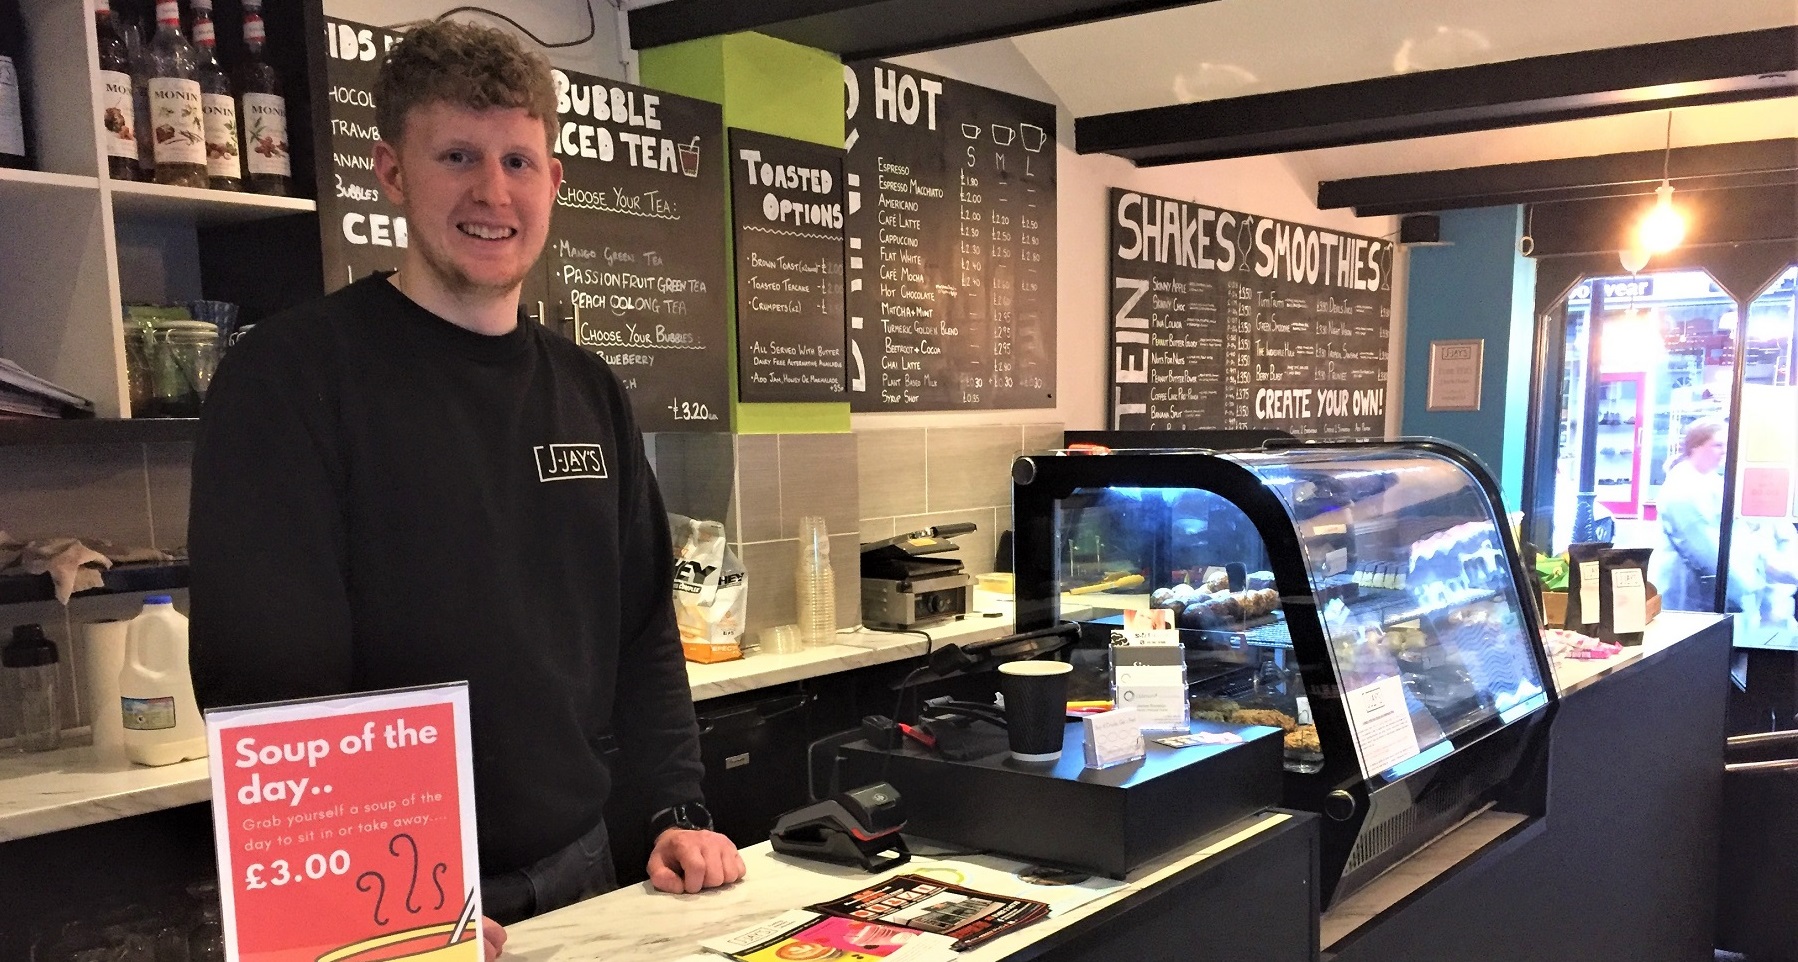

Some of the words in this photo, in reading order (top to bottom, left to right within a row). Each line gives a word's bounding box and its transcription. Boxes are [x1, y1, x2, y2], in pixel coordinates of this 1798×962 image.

[326, 23, 377, 62] IDS
[154, 89, 198, 102] MONIN
[551, 69, 661, 130] BUBBLE
[874, 66, 943, 131] HOT
[202, 106, 234, 116] ONIN
[619, 132, 678, 173] TEA
[967, 146, 976, 167] S
[996, 153, 1005, 170] M
[1026, 156, 1035, 177] L
[740, 149, 833, 195] TOASTED
[878, 157, 910, 176] ESPRESSO
[557, 180, 606, 206] CHOOSE
[613, 187, 640, 209] YOUR
[878, 175, 908, 193] ESPRESSO
[910, 179, 944, 198] MACCHIATO
[762, 192, 844, 229] OPTIONS
[878, 193, 919, 212] AMERICANO
[899, 213, 921, 230] LATTE
[879, 228, 919, 247] CAPPUCCINO
[1117, 193, 1236, 272] SHAKES
[1255, 218, 1381, 292] SMOOTHIES
[559, 239, 596, 258] MANGO
[604, 247, 635, 266] GREEN
[643, 251, 663, 266] TEA
[751, 252, 776, 269] BROWN
[880, 247, 897, 261] FLAT
[899, 249, 922, 266] WHITE
[750, 276, 781, 291] TOASTED
[901, 266, 924, 283] MOCHA
[1171, 278, 1187, 293] APPLE
[657, 279, 686, 294] GREEN
[688, 279, 707, 294] TEA
[880, 283, 895, 298] HOT
[900, 285, 935, 301] CHOCOLATE
[571, 289, 606, 309] PEACH
[663, 299, 687, 316] TEA
[580, 322, 622, 343] CHOOSE
[626, 323, 653, 343] YOUR
[881, 319, 912, 335] TURMERIC
[940, 320, 959, 336] BLEND
[753, 341, 768, 355] ALL
[770, 341, 797, 355] SERVED
[799, 344, 815, 356] WITH
[881, 356, 898, 370] CHAI
[901, 357, 922, 371] LATTE
[904, 390, 919, 403] SHOT
[1255, 388, 1312, 420] CREATE
[1317, 388, 1349, 417] YOUR
[1353, 388, 1384, 416] OWN!
[235, 738, 330, 768] Soup
[339, 720, 376, 755] of
[383, 718, 438, 749] the
[237, 773, 333, 807] day..
[242, 815, 282, 831] Grab
[287, 803, 345, 830] yourself
[350, 804, 359, 815] a
[364, 799, 397, 816] soup
[402, 793, 416, 808] of
[420, 791, 442, 805] the
[244, 838, 272, 852] day
[277, 834, 292, 847] to
[298, 830, 315, 843] sit
[320, 826, 333, 840] in
[338, 825, 353, 837] or
[357, 820, 388, 834] take
[245, 849, 351, 892] £3.00
